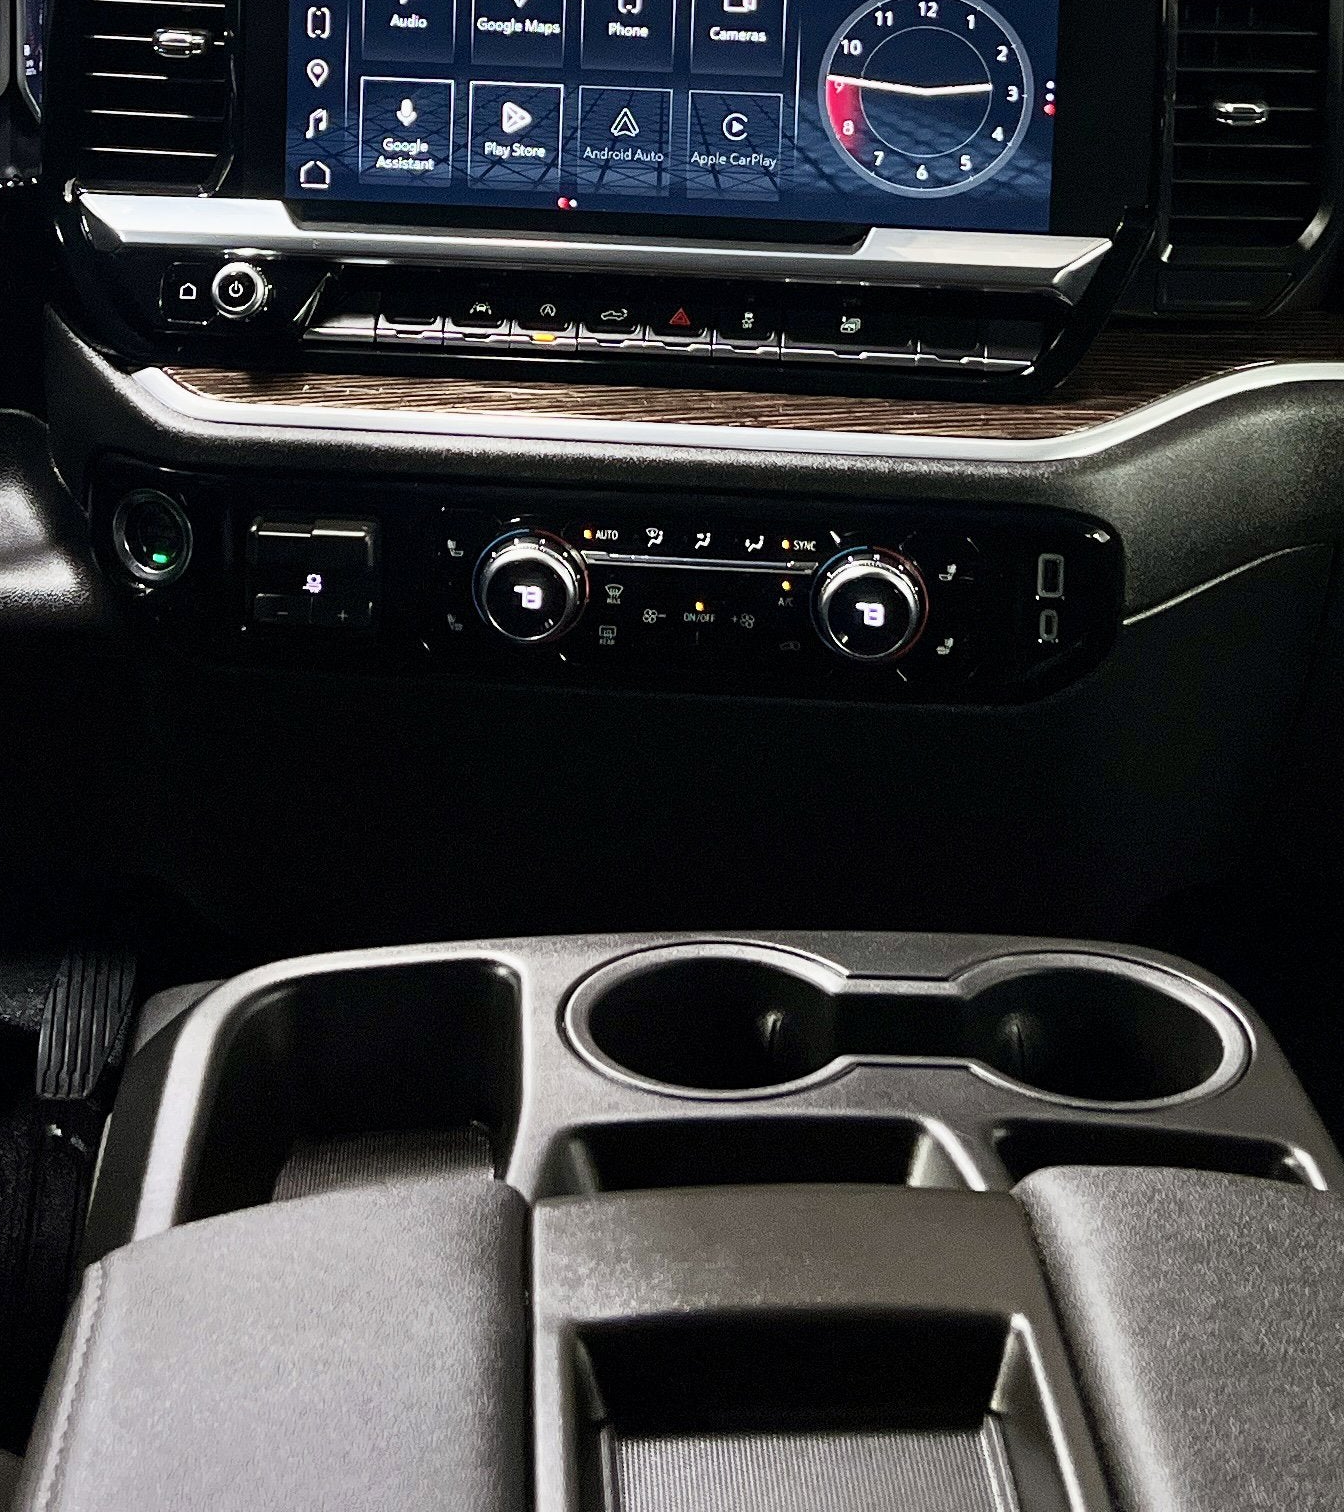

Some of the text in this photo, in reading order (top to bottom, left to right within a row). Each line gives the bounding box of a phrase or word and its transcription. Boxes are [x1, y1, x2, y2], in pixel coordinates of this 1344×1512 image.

[918, 1, 938, 18] 12
[390, 14, 427, 28] Audio
[875, 10, 894, 26] 11
[966, 14, 975, 29] 1
[477, 17, 560, 36] Google Maps
[608, 22, 649, 37] Phone
[710, 26, 767, 42] Cameras
[841, 39, 862, 55] 10
[996, 46, 1008, 62] 2
[1006, 85, 1019, 102] 3
[842, 120, 854, 136] 8
[992, 126, 1004, 142] 4
[383, 138, 429, 155] Google
[484, 141, 546, 158] Play Store
[583, 147, 664, 162] Android Auto
[375, 155, 435, 170] Assistant
[691, 152, 777, 169] Apple CarPlay
[874, 151, 884, 166] 7
[960, 155, 972, 171] 5
[916, 165, 928, 180] 6
[595, 530, 618, 540] AUTO
[793, 541, 817, 551] SYNC
[778, 598, 794, 607] A/C
[683, 613, 716, 623] ON/OFF
